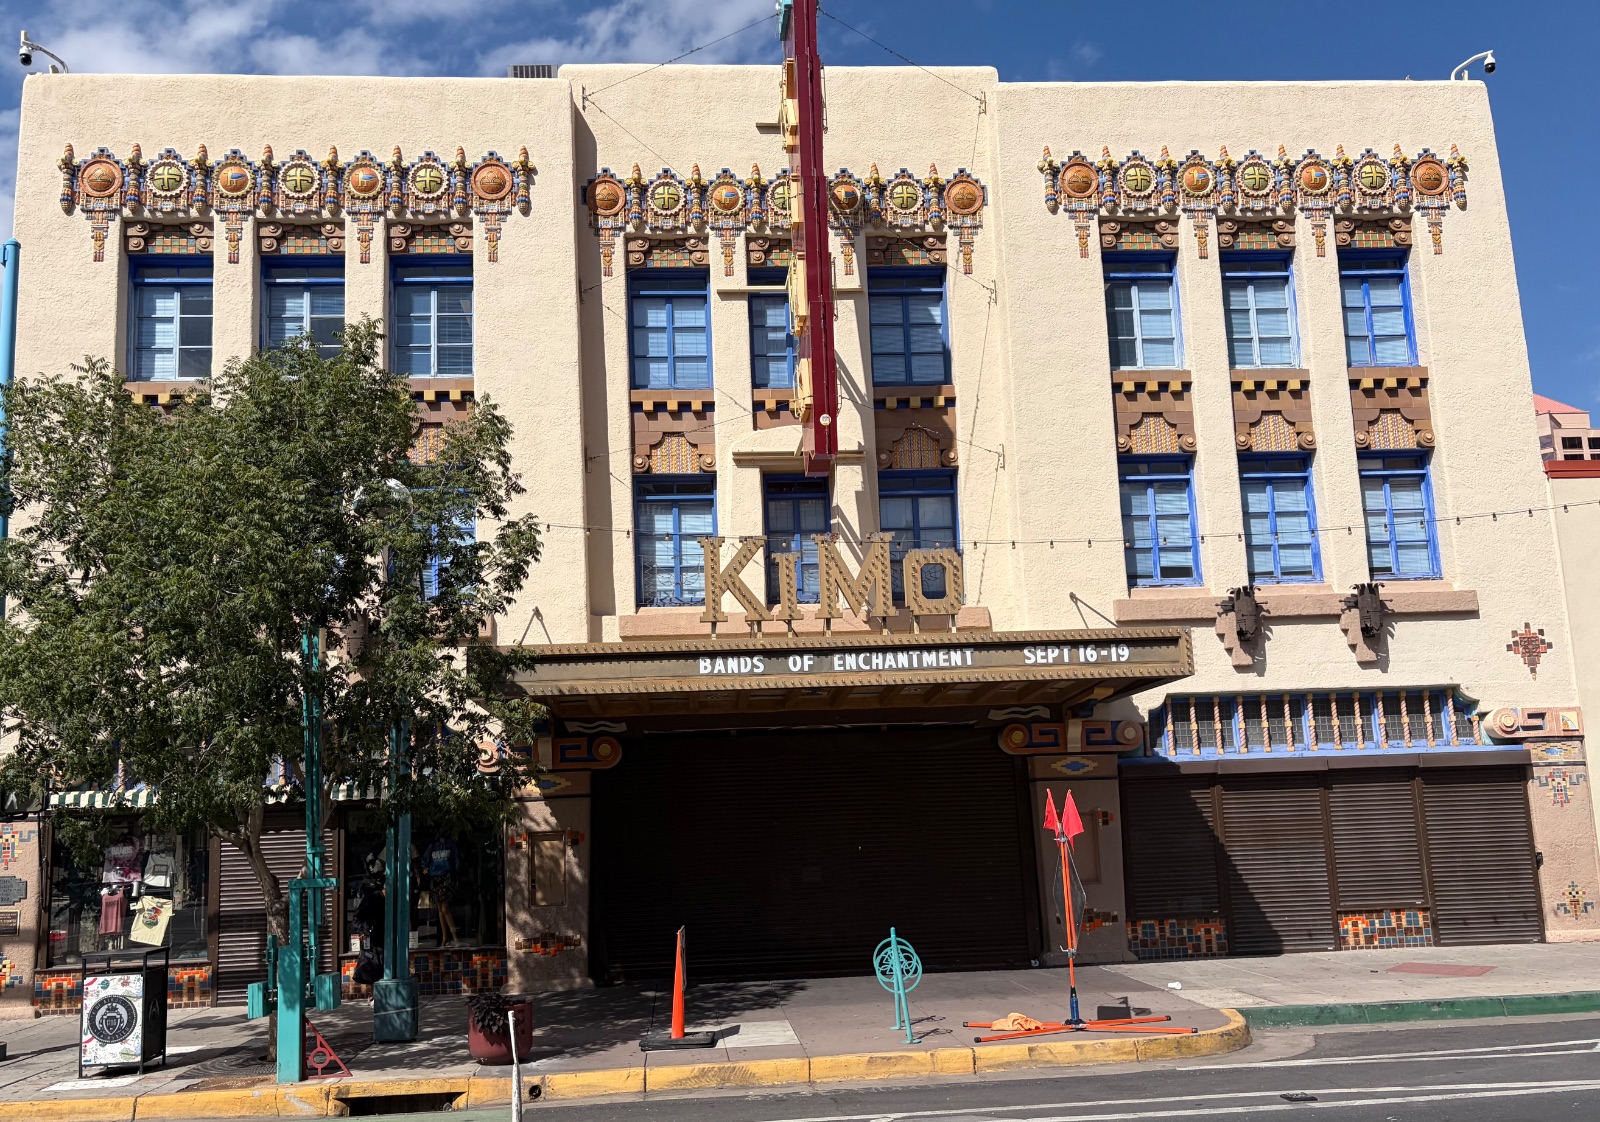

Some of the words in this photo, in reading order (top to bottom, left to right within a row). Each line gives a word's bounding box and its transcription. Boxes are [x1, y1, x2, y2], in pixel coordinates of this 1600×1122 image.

[699, 655, 765, 674] BANDS
[788, 654, 814, 672] OF
[833, 649, 974, 670] ENCHANTMENT
[1023, 645, 1071, 664] SEPT
[1079, 644, 1130, 663] 16-19
